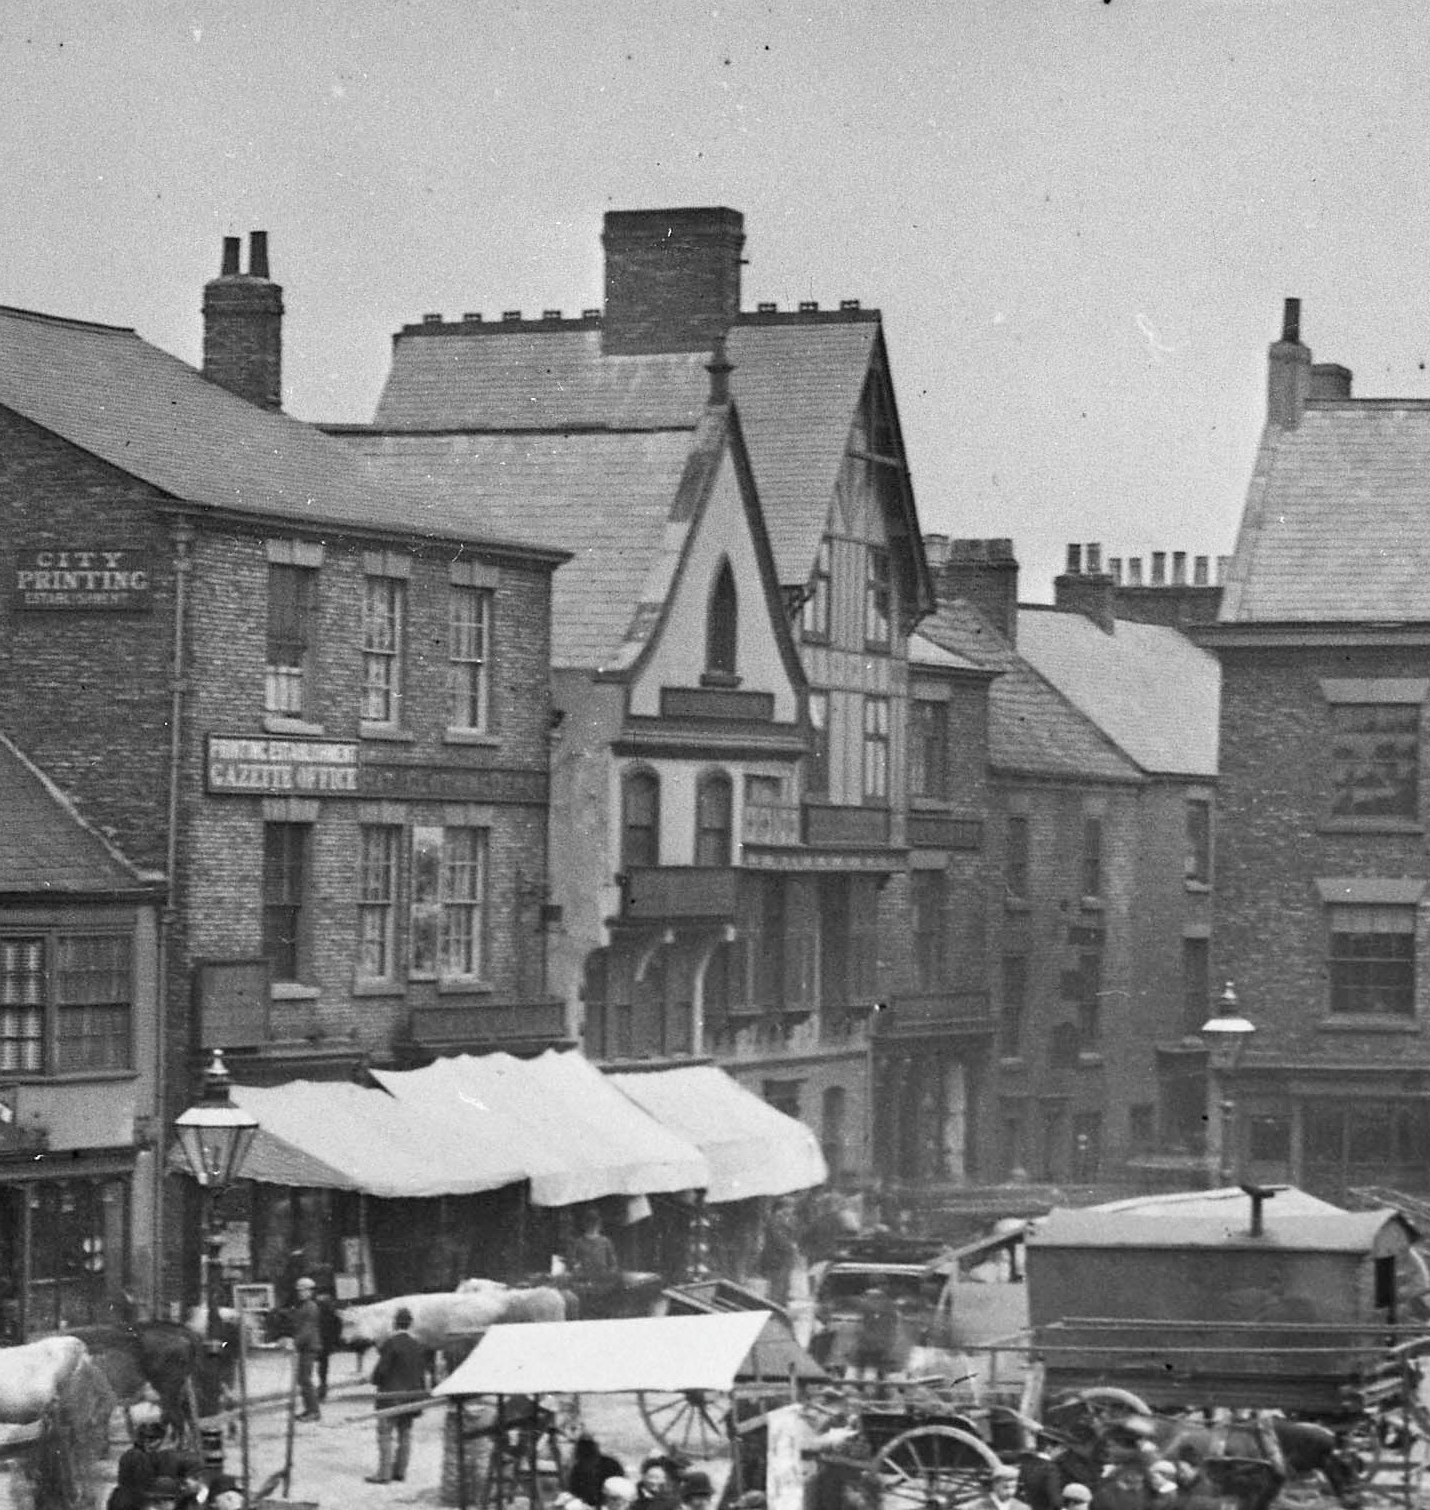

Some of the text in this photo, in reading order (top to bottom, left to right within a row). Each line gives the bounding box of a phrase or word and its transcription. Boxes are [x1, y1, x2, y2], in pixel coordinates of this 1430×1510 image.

[36, 551, 126, 568] CITY
[16, 570, 148, 590] PRINTING
[210, 764, 292, 789] GAZETTE
[296, 767, 358, 790] OFFICE
